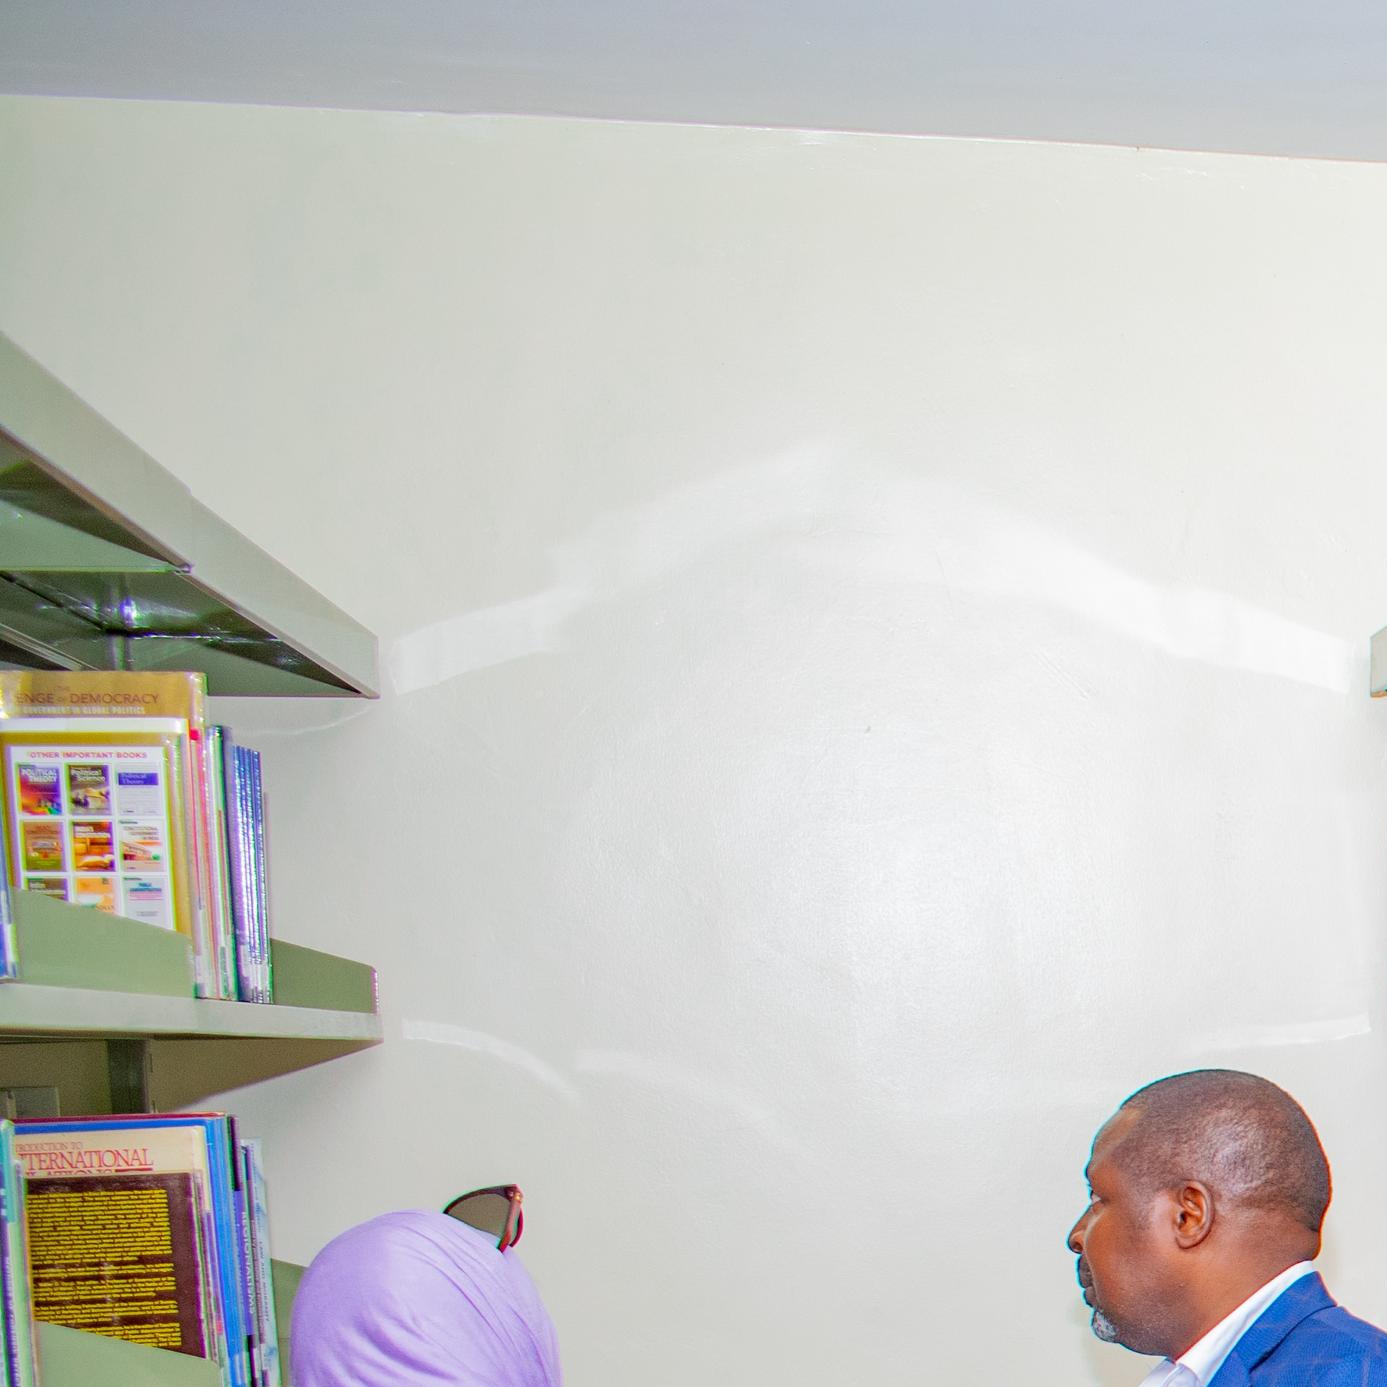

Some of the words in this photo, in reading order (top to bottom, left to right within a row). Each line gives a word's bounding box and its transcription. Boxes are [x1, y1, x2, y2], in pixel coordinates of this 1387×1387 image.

[69, 693, 160, 704] DEMOCRACY
[30, 751, 60, 759] OTHER
[63, 751, 113, 759] IMPORTANT
[117, 751, 147, 759] BOOKS
[20, 1148, 154, 1172] TERNATIONAL
